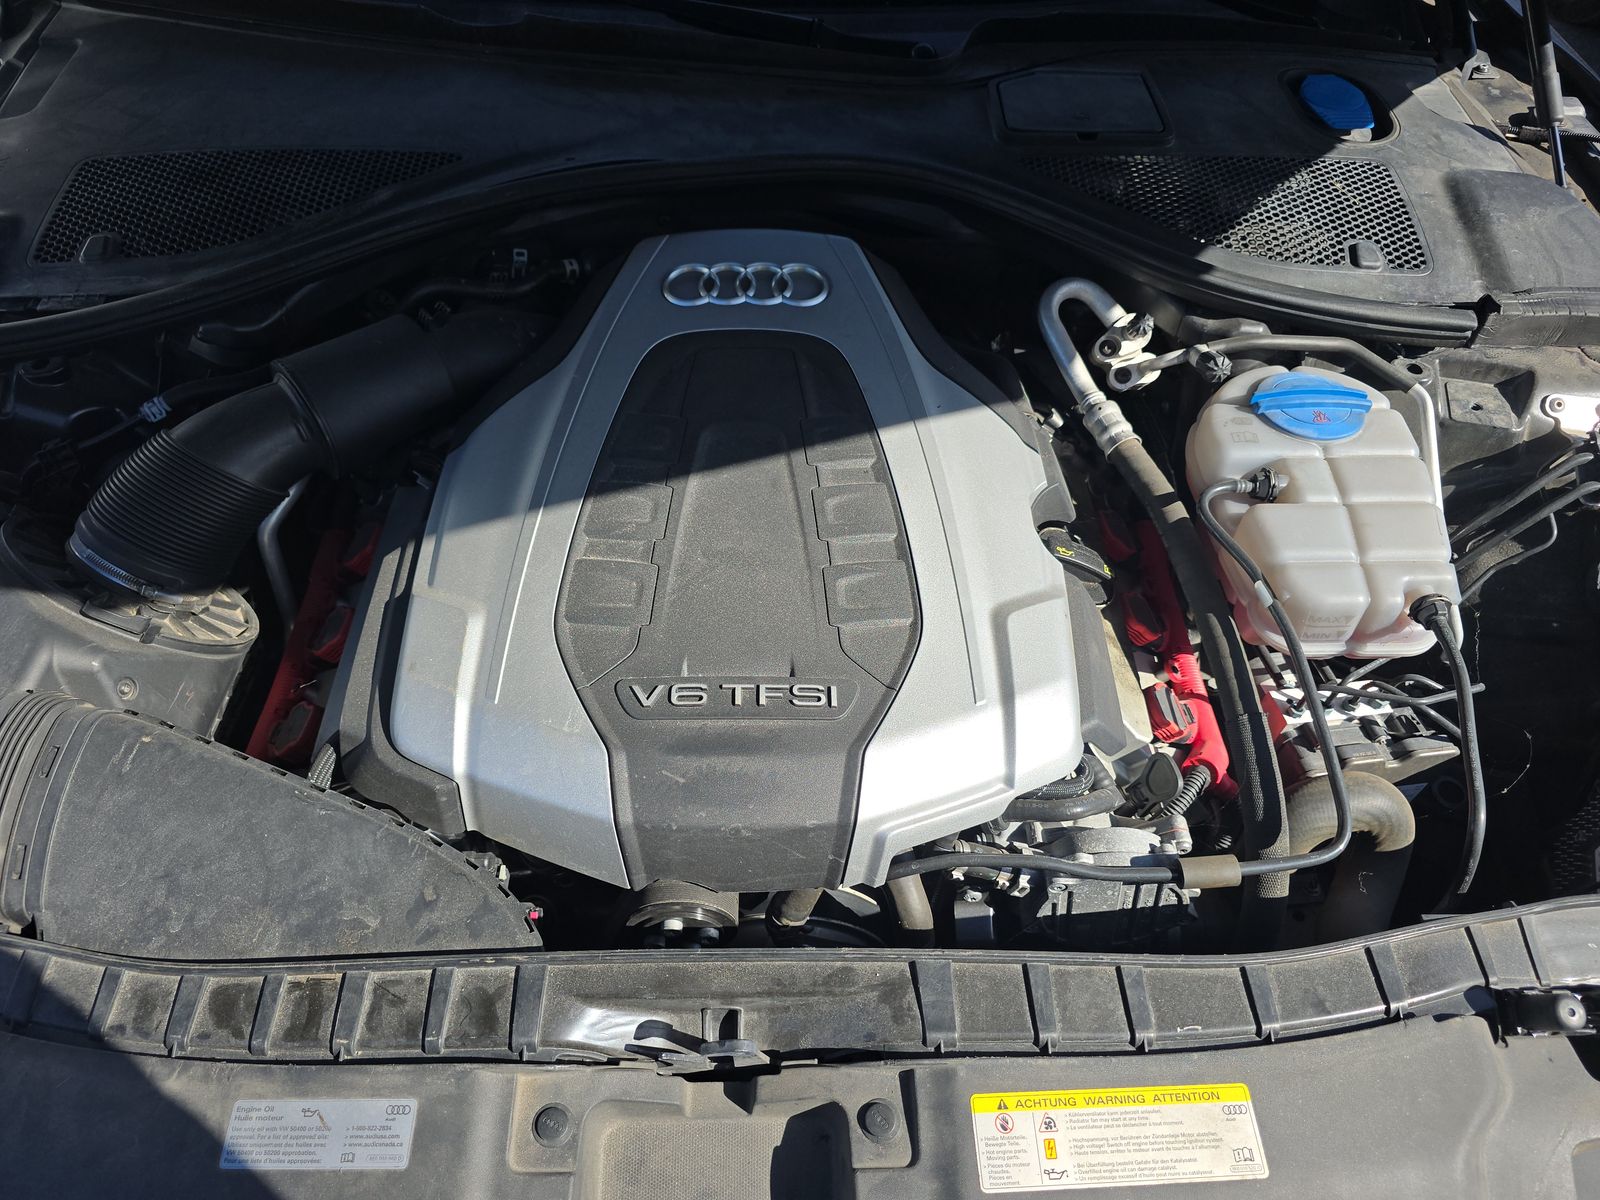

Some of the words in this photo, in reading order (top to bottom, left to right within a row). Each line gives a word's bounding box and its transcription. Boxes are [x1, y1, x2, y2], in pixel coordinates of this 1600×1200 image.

[1308, 615, 1344, 624] MAX
[1301, 632, 1332, 640] MIN
[628, 683, 708, 708] V6
[720, 683, 838, 708] TFSI
[1015, 1098, 1077, 1109] ACHTUNG
[1084, 1094, 1146, 1105] WARNING
[1152, 1091, 1221, 1103] ATTENTION
[236, 1106, 262, 1114] Engine
